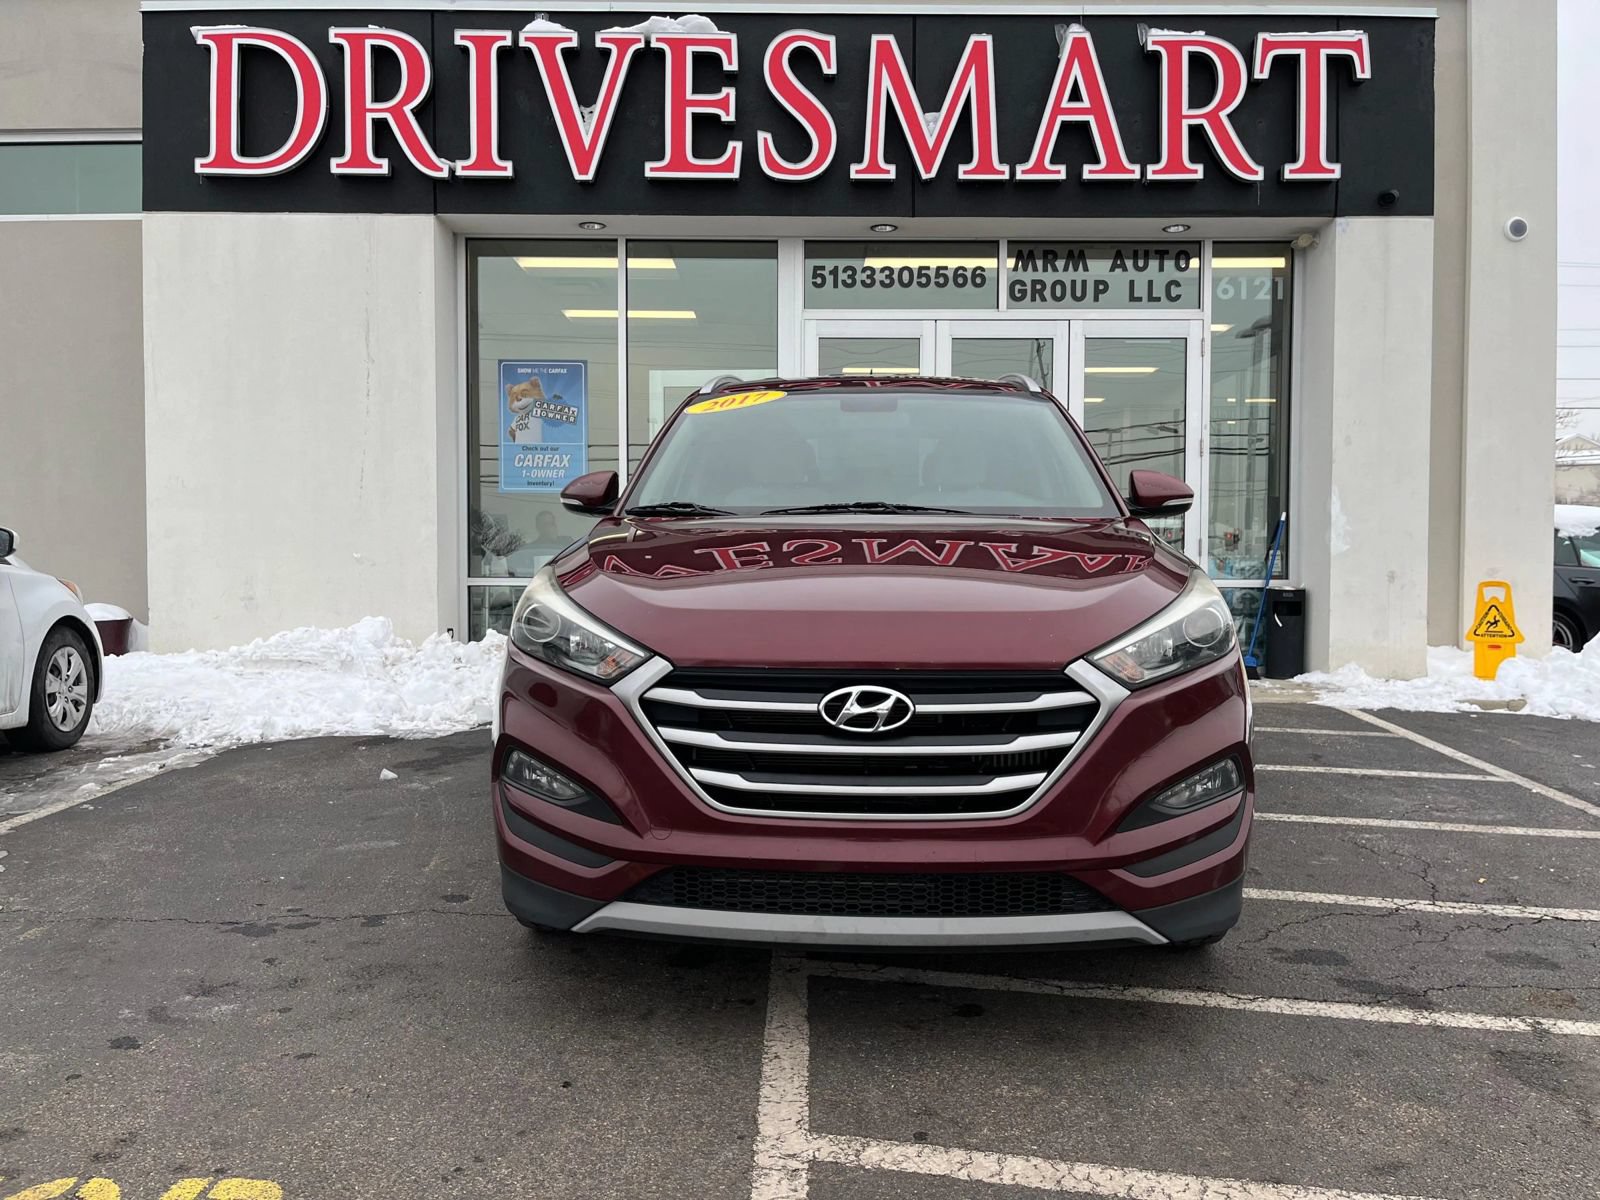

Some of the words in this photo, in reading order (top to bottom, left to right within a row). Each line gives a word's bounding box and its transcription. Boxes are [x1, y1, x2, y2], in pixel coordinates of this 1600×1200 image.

[194, 27, 1372, 183] DRIVESMART
[1012, 249, 1089, 273] MRM
[1109, 249, 1190, 273] AUTO
[811, 265, 987, 289] 5133305566
[1009, 279, 1109, 302] GROUP
[1128, 279, 1182, 302] LLC
[1216, 276, 1284, 300] 6121
[535, 400, 577, 416] CARFAX
[702, 392, 769, 411] 2017
[515, 415, 529, 424] CAR
[541, 410, 576, 422] OWNER
[515, 422, 530, 431] FOX
[514, 454, 571, 467] CARFAX
[522, 469, 565, 478] 1-OWNER
